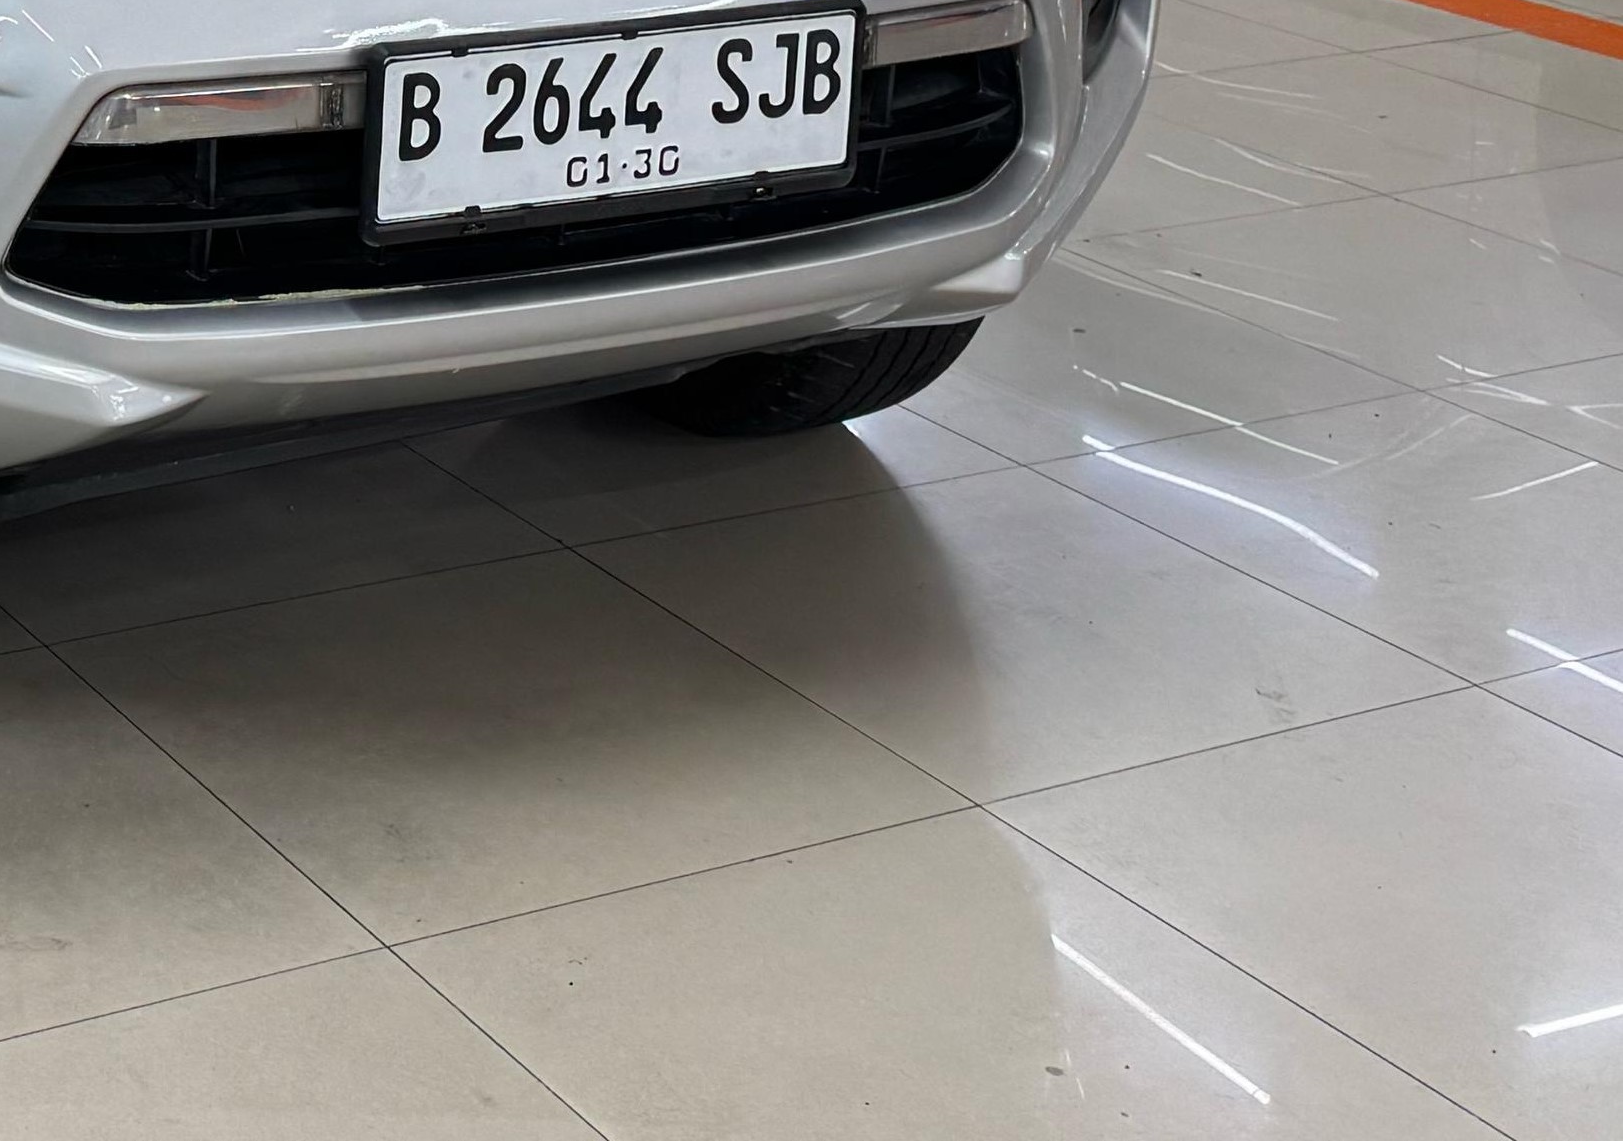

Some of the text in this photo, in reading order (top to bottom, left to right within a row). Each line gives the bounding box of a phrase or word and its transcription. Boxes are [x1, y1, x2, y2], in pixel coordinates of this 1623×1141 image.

[398, 28, 841, 162] B 2644 SJB
